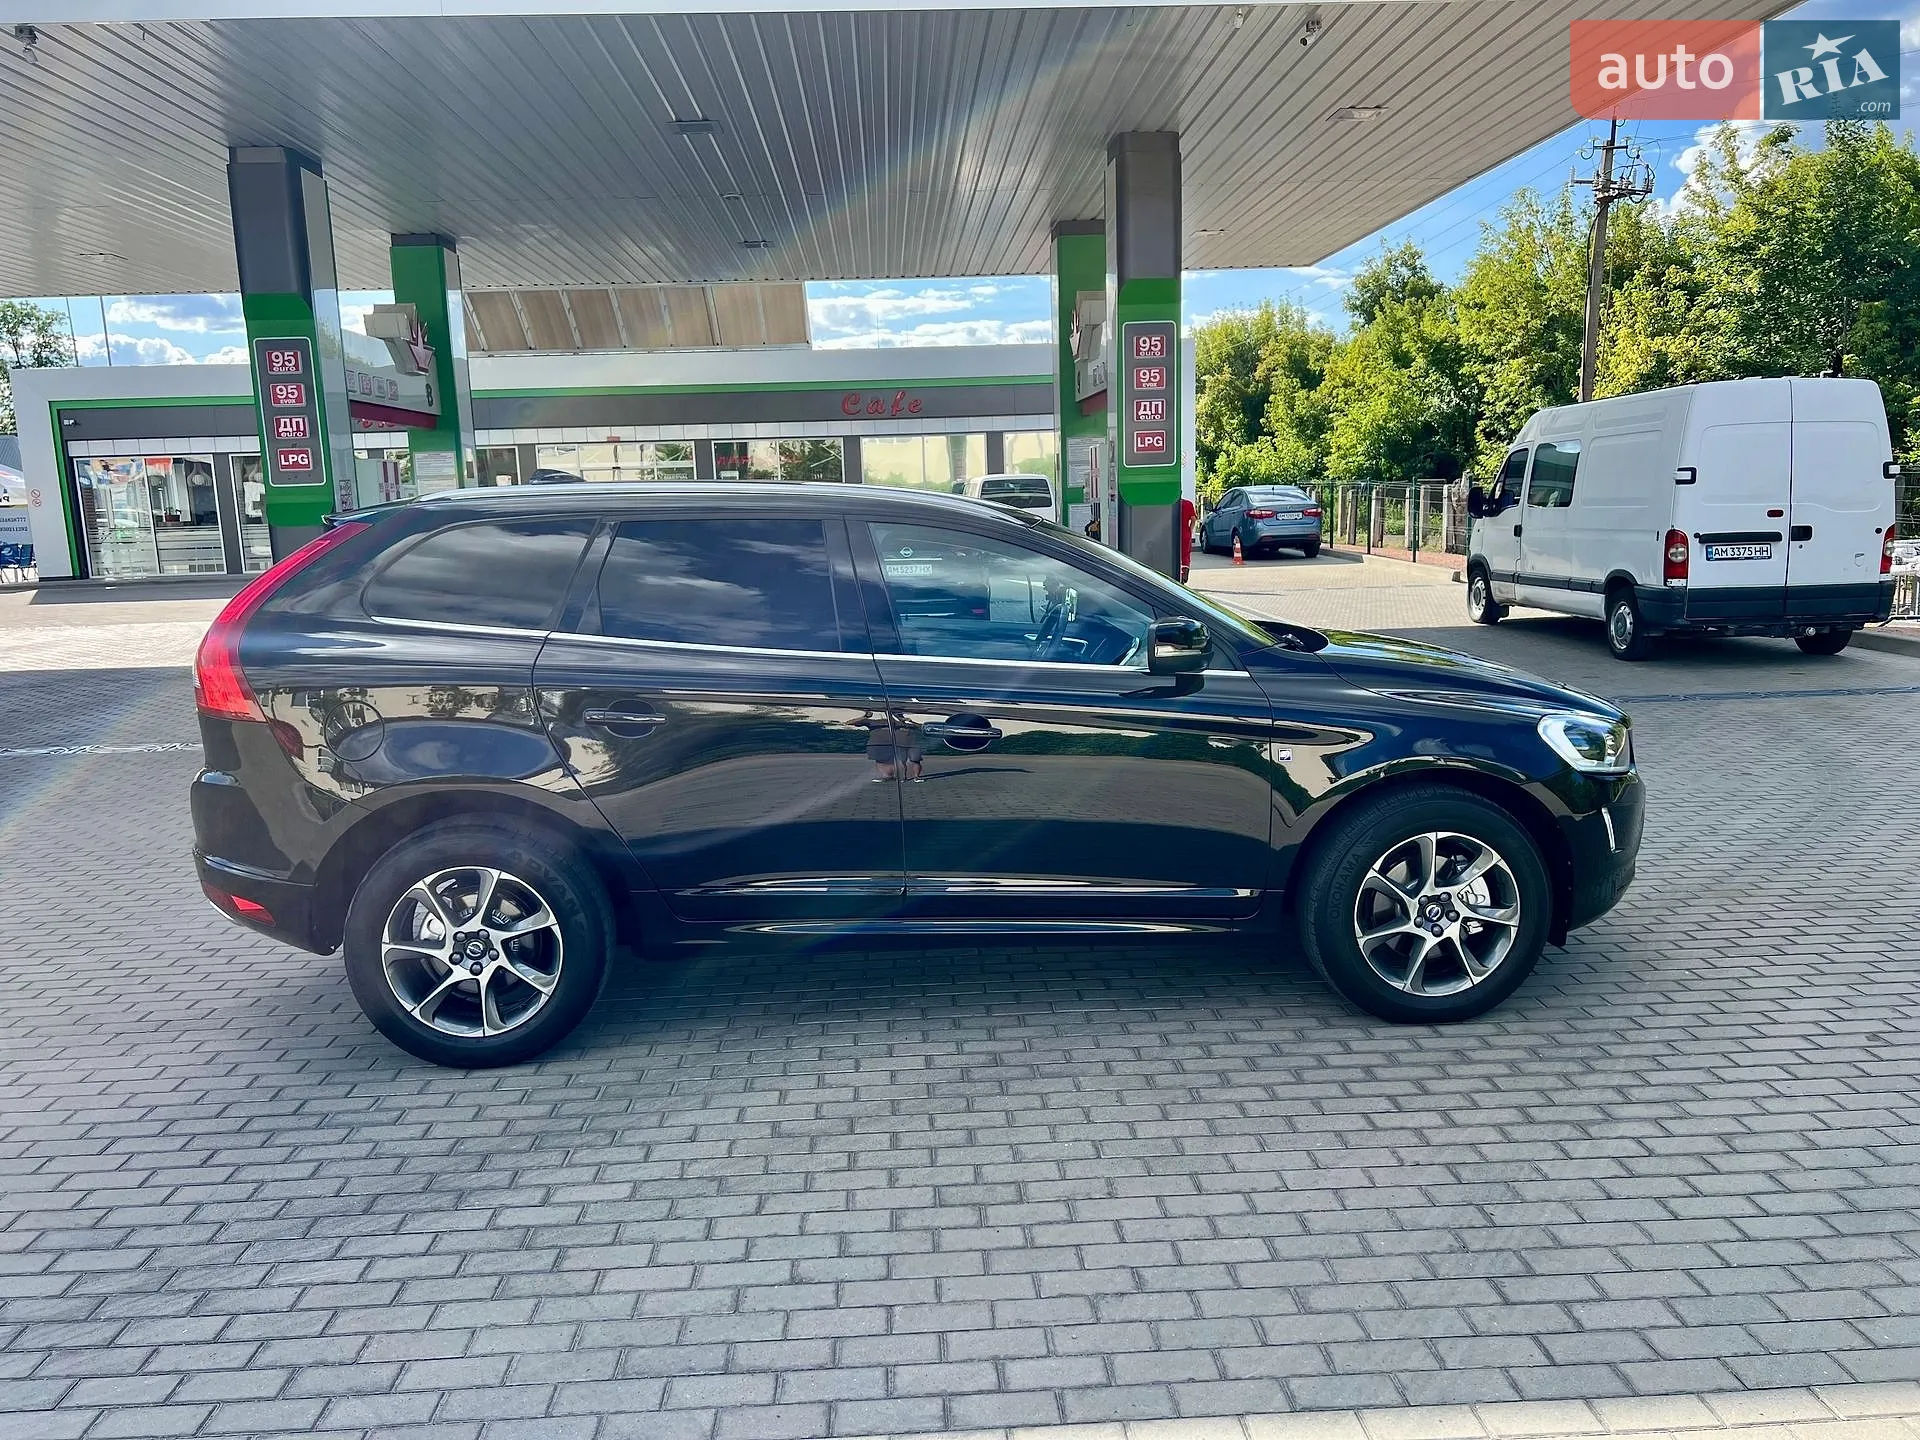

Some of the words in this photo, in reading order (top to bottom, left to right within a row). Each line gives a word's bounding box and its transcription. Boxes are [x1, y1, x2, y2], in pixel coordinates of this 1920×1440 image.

[1139, 336, 1161, 351] 95
[271, 352, 296, 367] 95
[1139, 370, 1160, 382] 95
[275, 385, 298, 399] 95
[841, 390, 922, 416] Cafe
[1138, 401, 1162, 415] ДП
[278, 418, 304, 432] ДП
[1137, 436, 1163, 447] LPG
[280, 454, 309, 466] LPG
[1713, 548, 1728, 557] AM
[1730, 547, 1753, 557] 3375
[1754, 546, 1769, 556] HH
